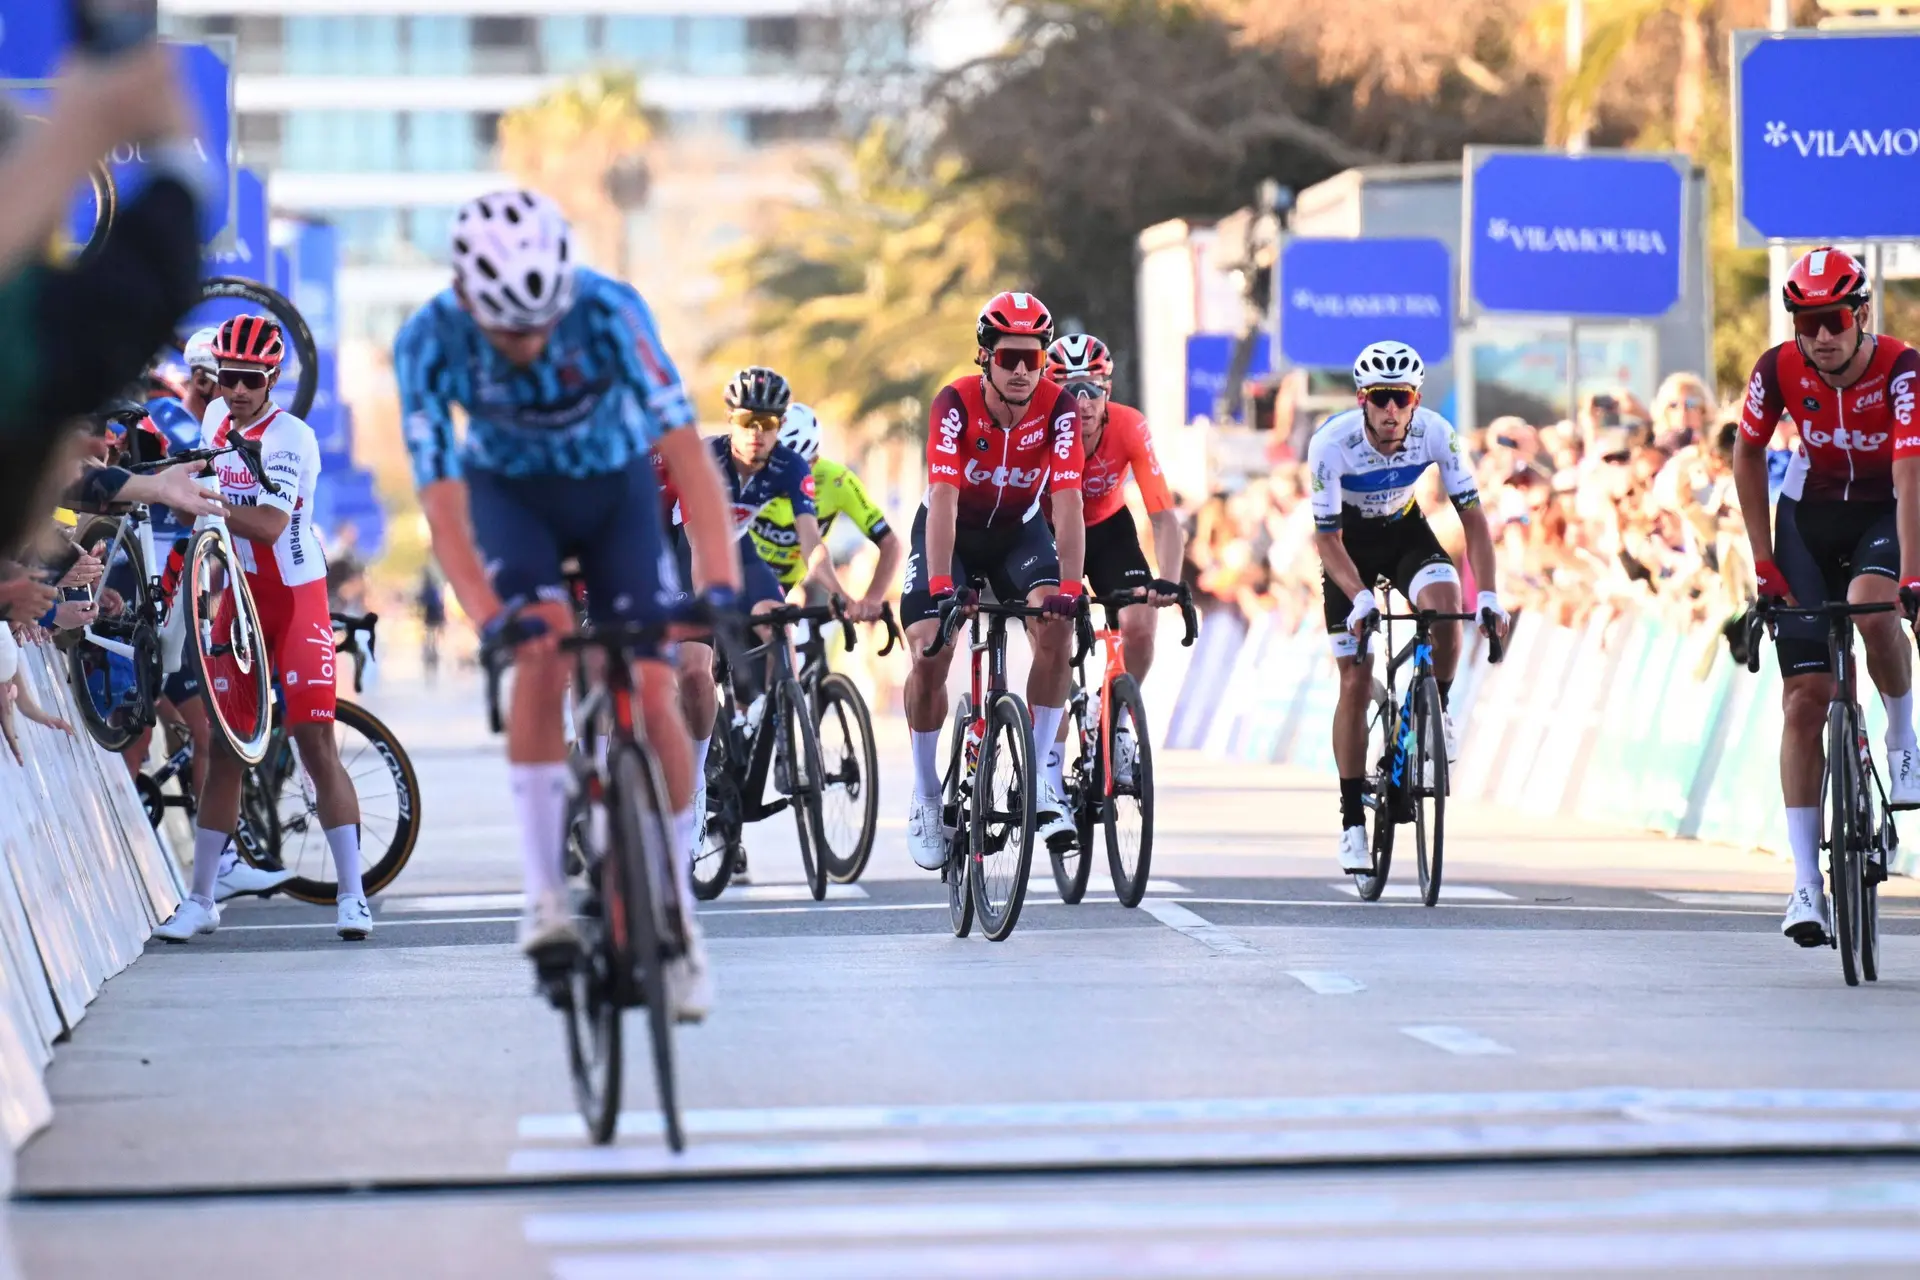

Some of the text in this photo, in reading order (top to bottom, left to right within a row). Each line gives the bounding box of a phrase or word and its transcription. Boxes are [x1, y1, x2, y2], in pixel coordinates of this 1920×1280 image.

[1791, 128, 1920, 157] VILAMO
[1509, 226, 1667, 255] VILAMOURA
[1020, 427, 1044, 446] CAPS
[290, 514, 304, 565] IMOPROMO
[310, 709, 333, 719] FIAAL
